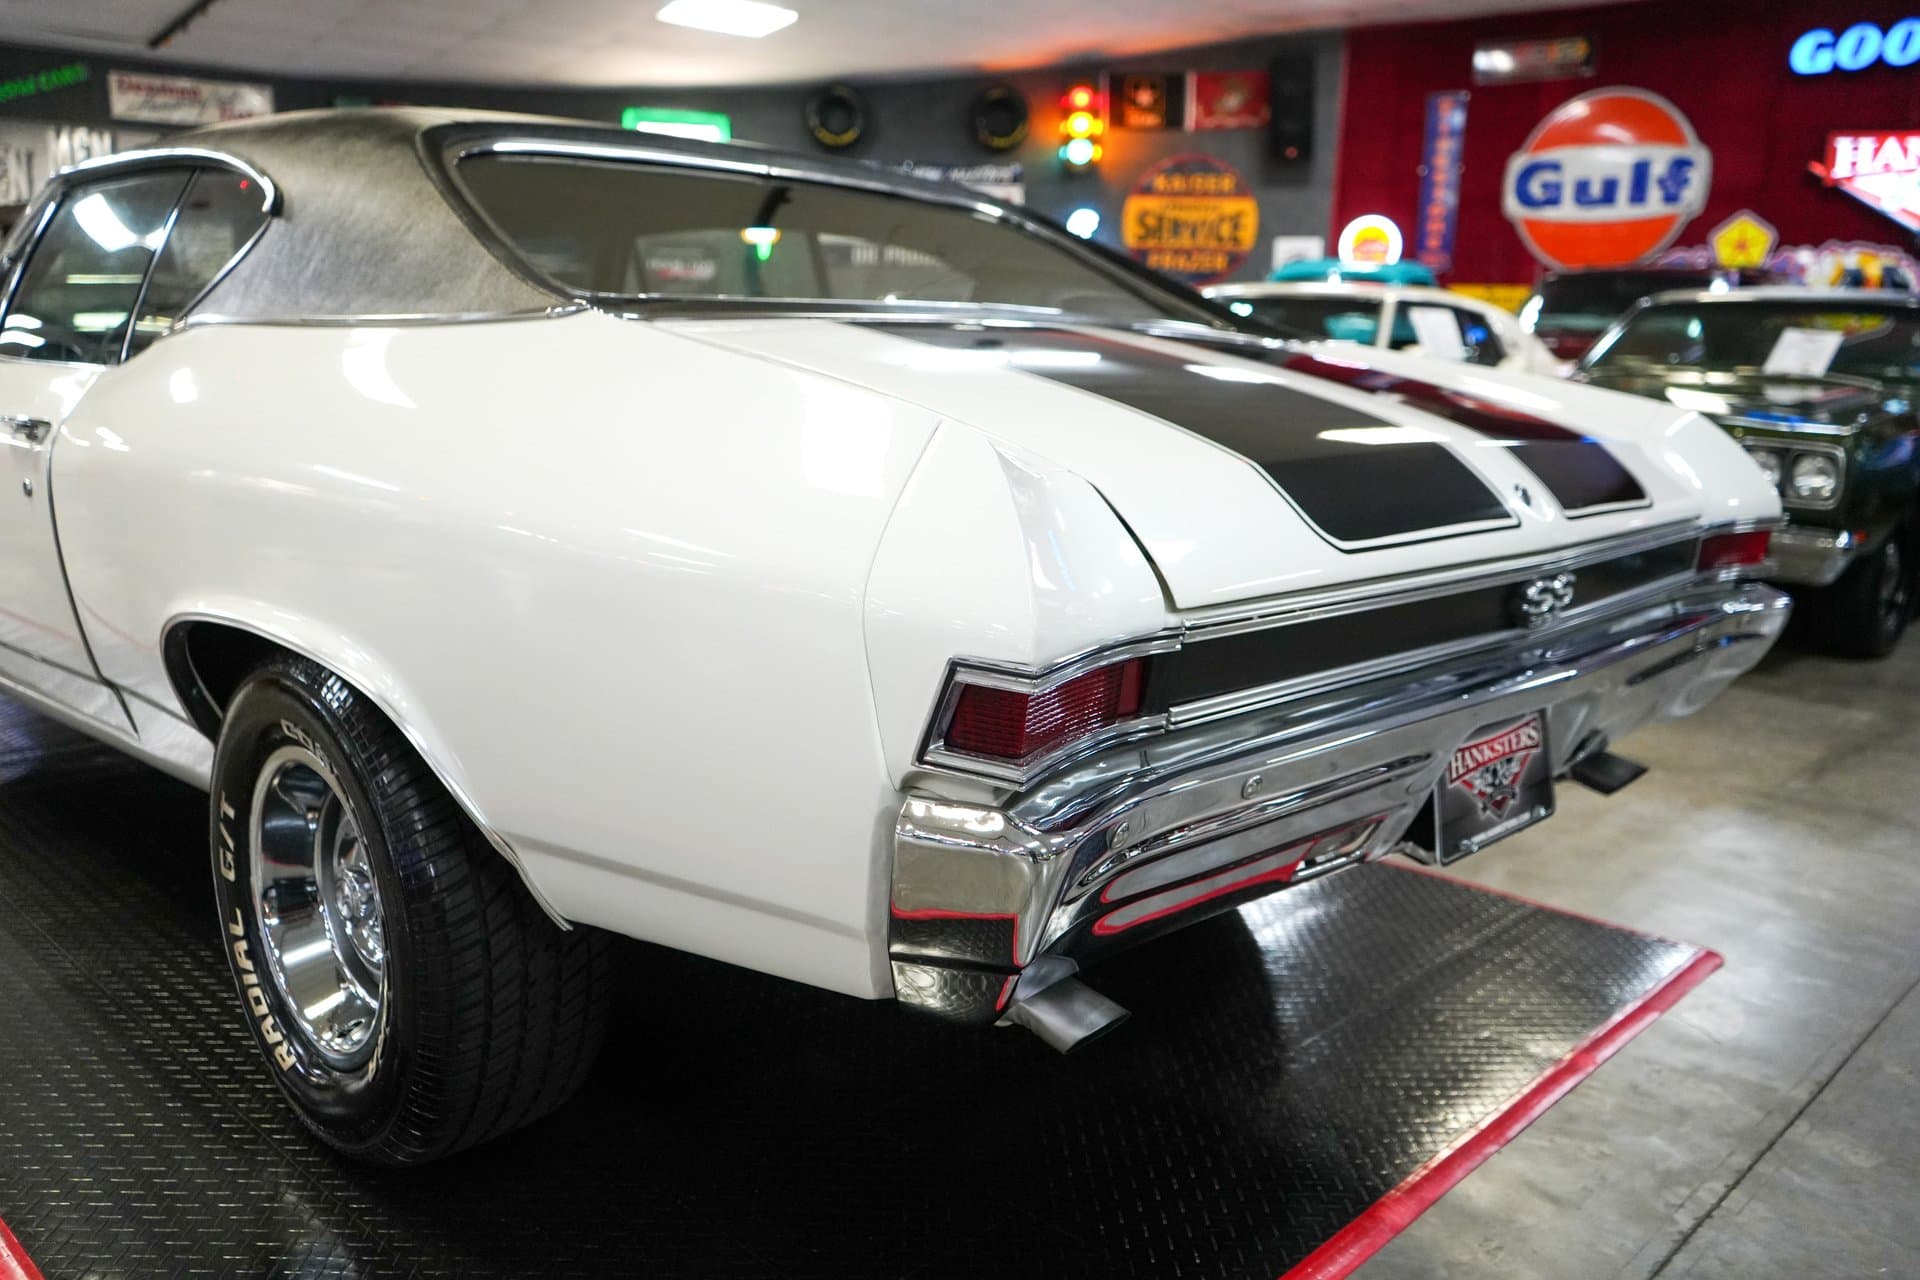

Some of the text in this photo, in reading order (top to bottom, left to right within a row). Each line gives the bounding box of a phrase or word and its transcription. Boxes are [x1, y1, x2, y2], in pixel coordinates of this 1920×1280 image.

[1515, 156, 1694, 208] Gulf
[1137, 209, 1244, 247] SERVICE
[1522, 573, 1576, 615] SS
[1450, 722, 1540, 780] HANKSTERS
[219, 790, 297, 1072] RADIAL G/T
